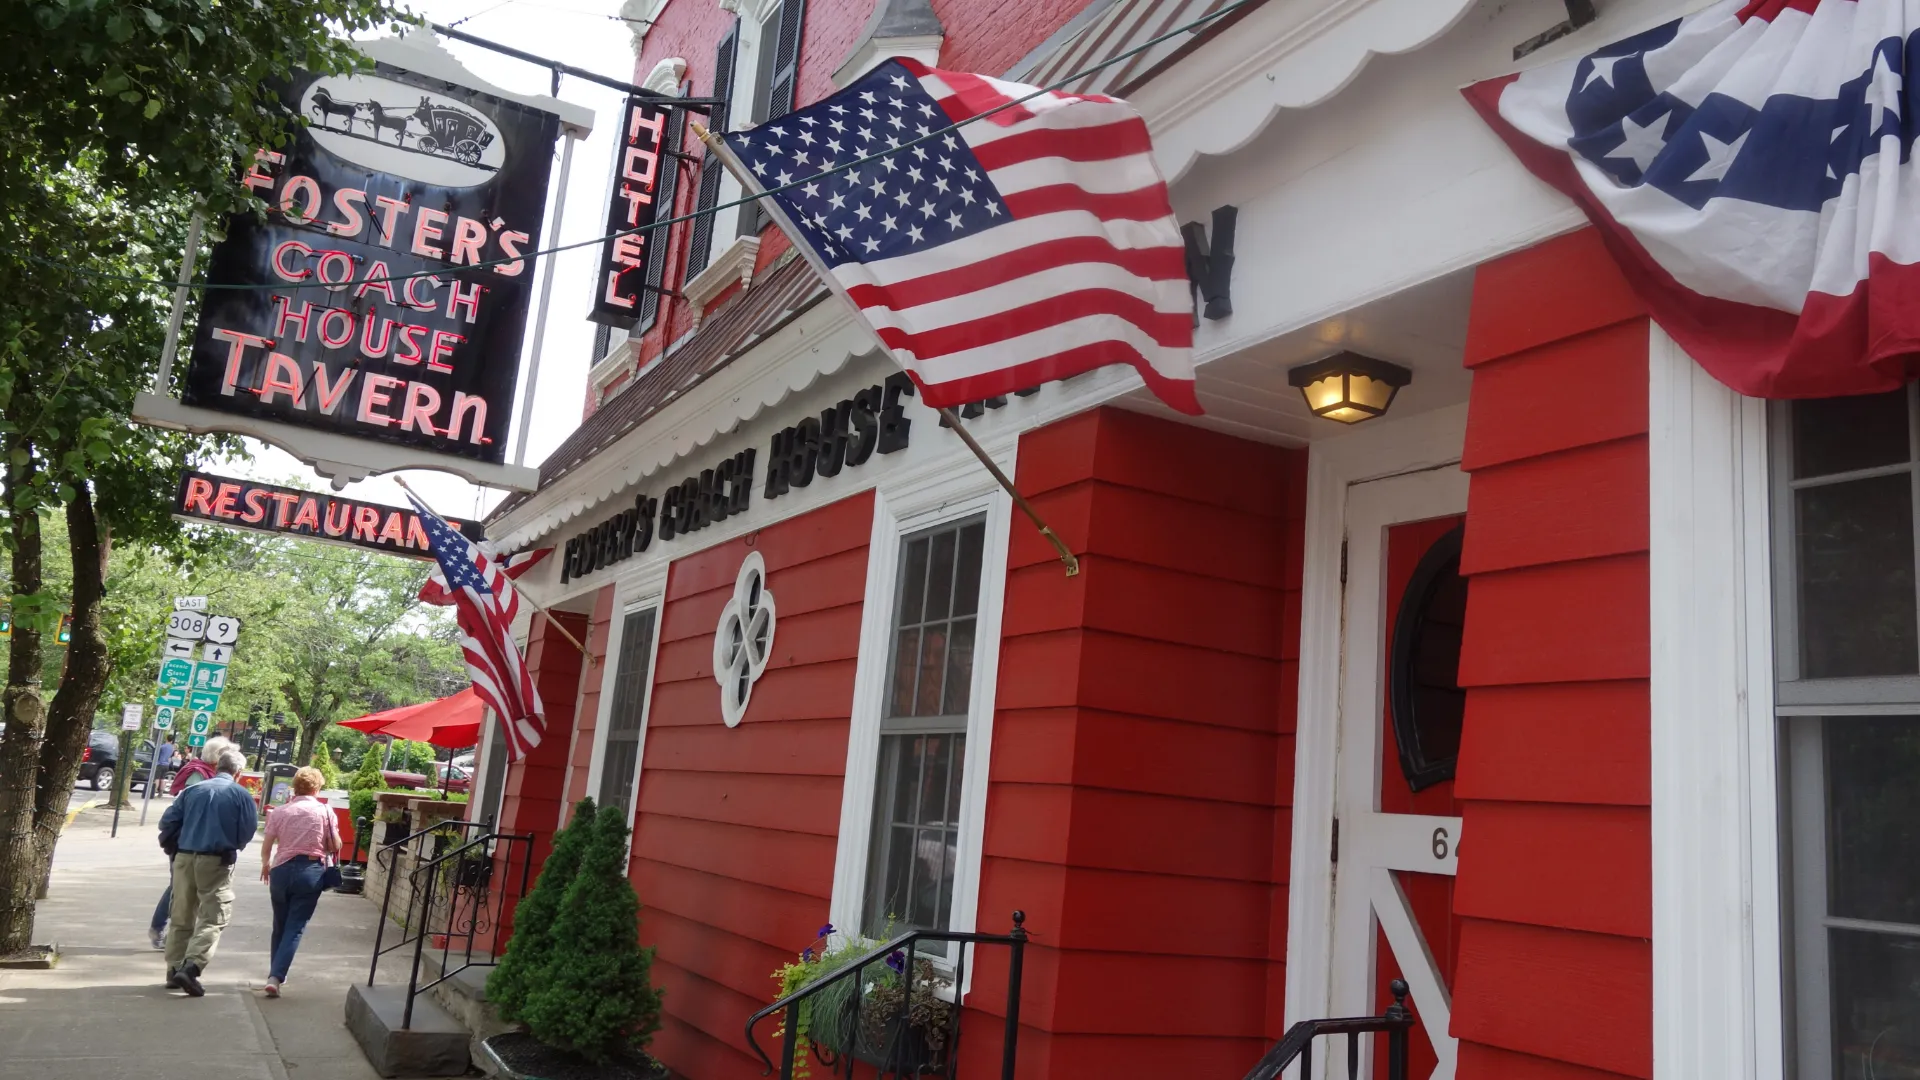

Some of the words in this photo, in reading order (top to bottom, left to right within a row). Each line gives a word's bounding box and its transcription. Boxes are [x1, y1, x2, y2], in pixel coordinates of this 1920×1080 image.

[242, 147, 530, 277] FOSTER'S
[605, 106, 664, 309] HOTEL
[271, 240, 482, 324] COACH
[273, 296, 466, 375] HOUSE
[184, 477, 462, 551] RESTAURAN
[560, 493, 658, 585] FOSTER'S
[659, 447, 757, 542] COACH
[764, 371, 915, 499] HOUSE
[169, 616, 203, 633] 308
[180, 598, 202, 608] EAST
[218, 622, 230, 638] 9
[197, 723, 204, 731] 9
[1432, 827, 1461, 860] 6
